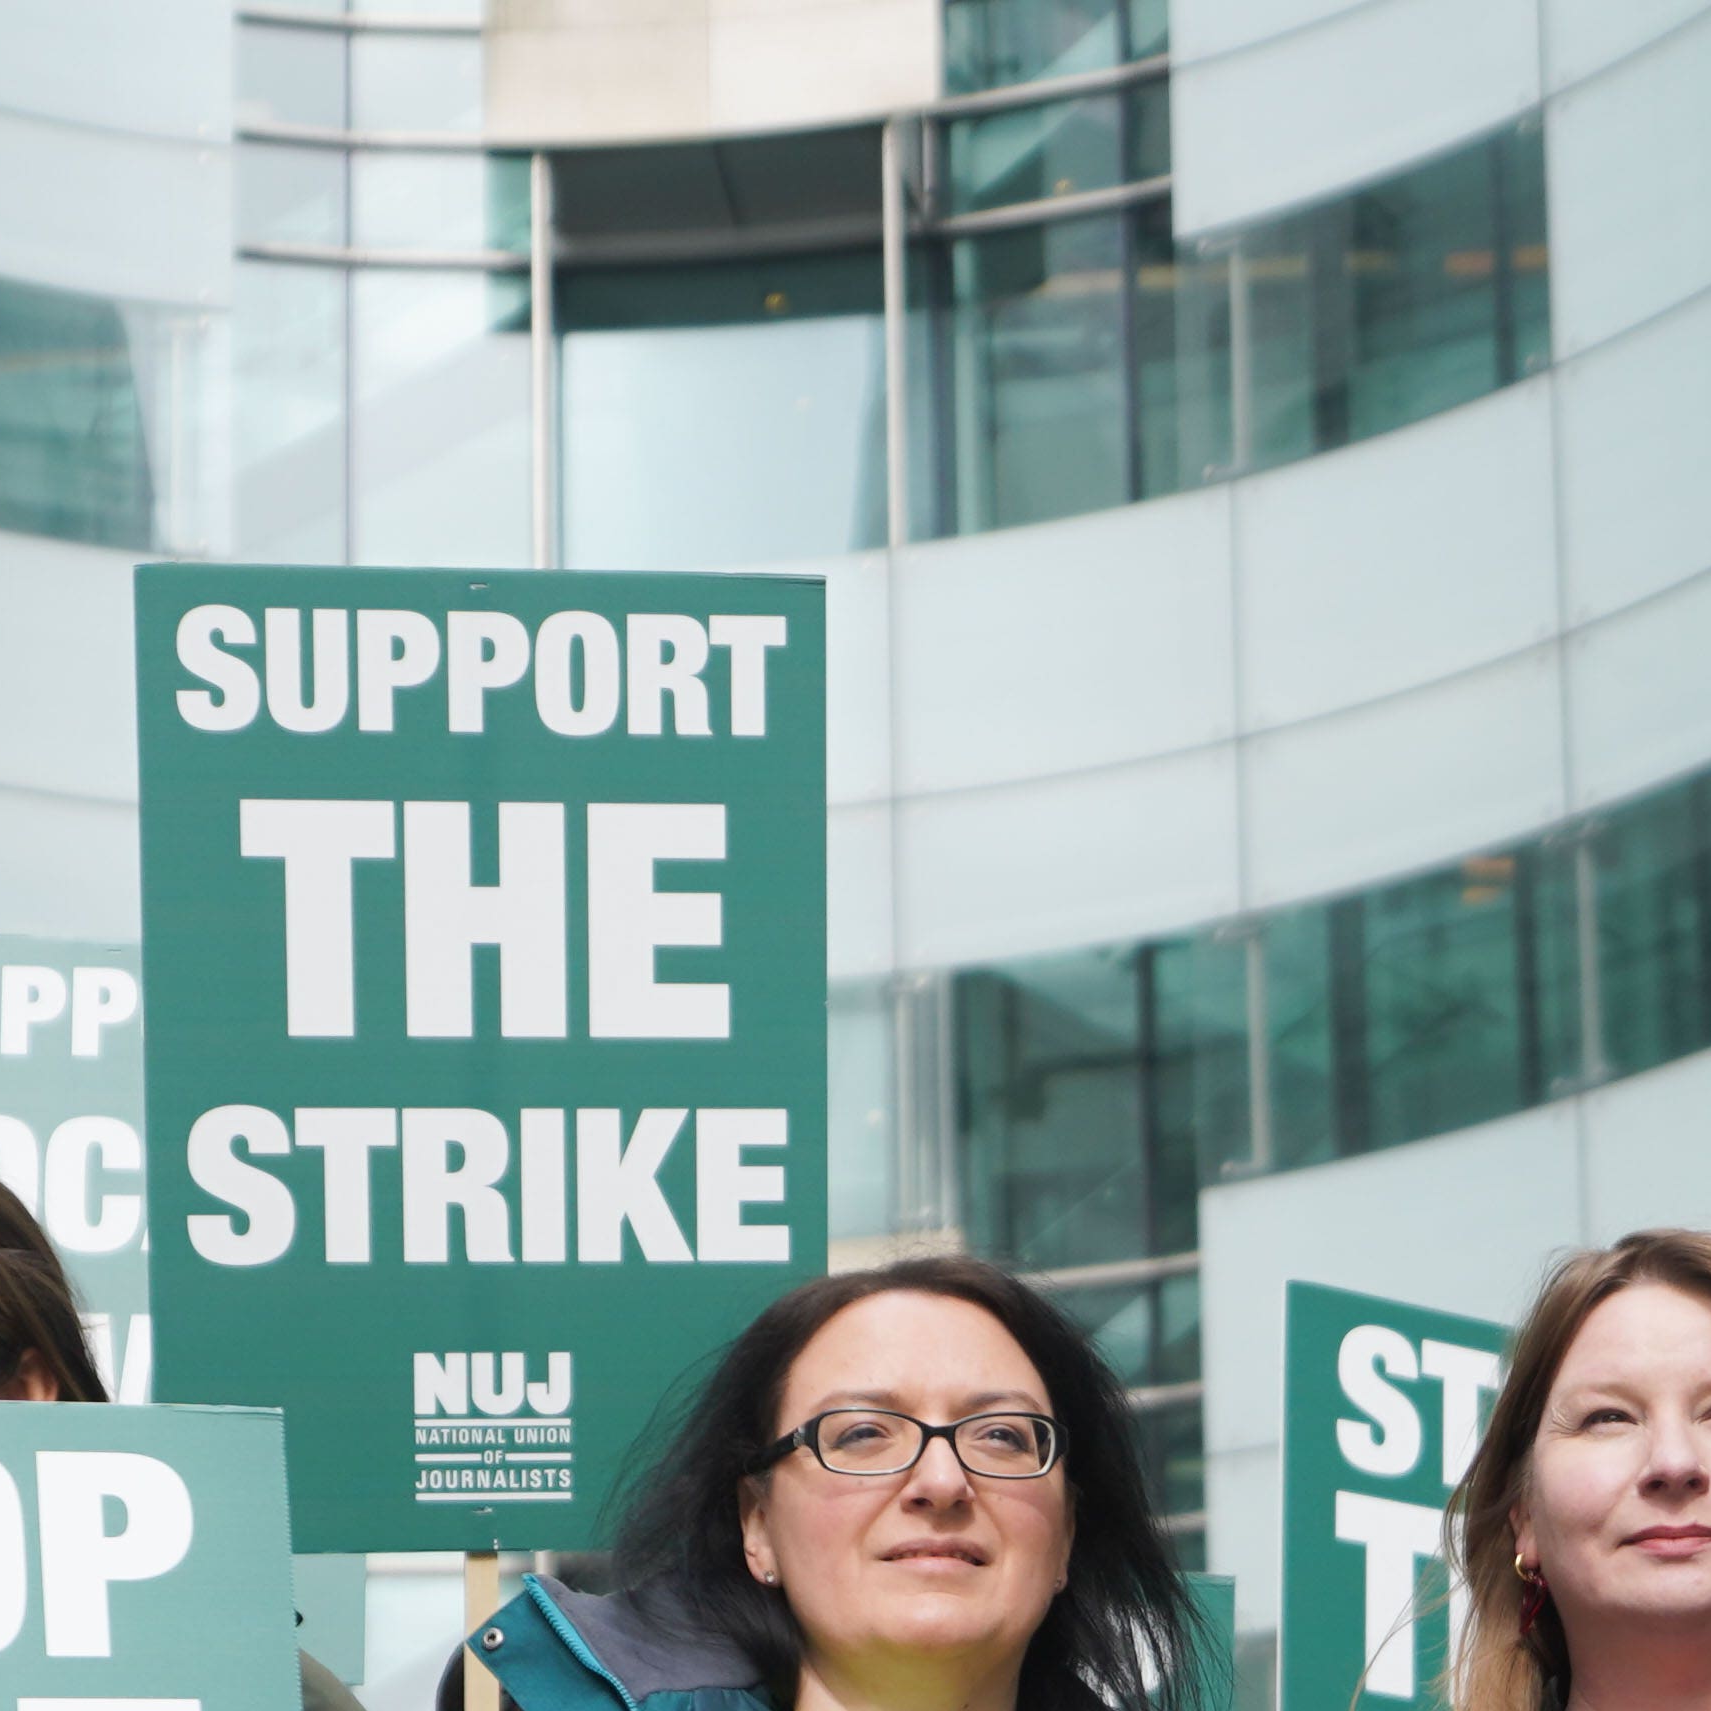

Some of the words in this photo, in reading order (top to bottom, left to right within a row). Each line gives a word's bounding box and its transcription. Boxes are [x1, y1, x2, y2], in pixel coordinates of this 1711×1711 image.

[175, 604, 786, 738] SUPPORT
[240, 799, 731, 1040] THE
[186, 1105, 790, 1267] STRIKE
[413, 1352, 571, 1415] NUJ
[415, 1428, 506, 1444] NATIONAL
[514, 1427, 570, 1443] UNION
[483, 1449, 503, 1464] OF
[415, 1469, 571, 1489] JOURNALISTS
